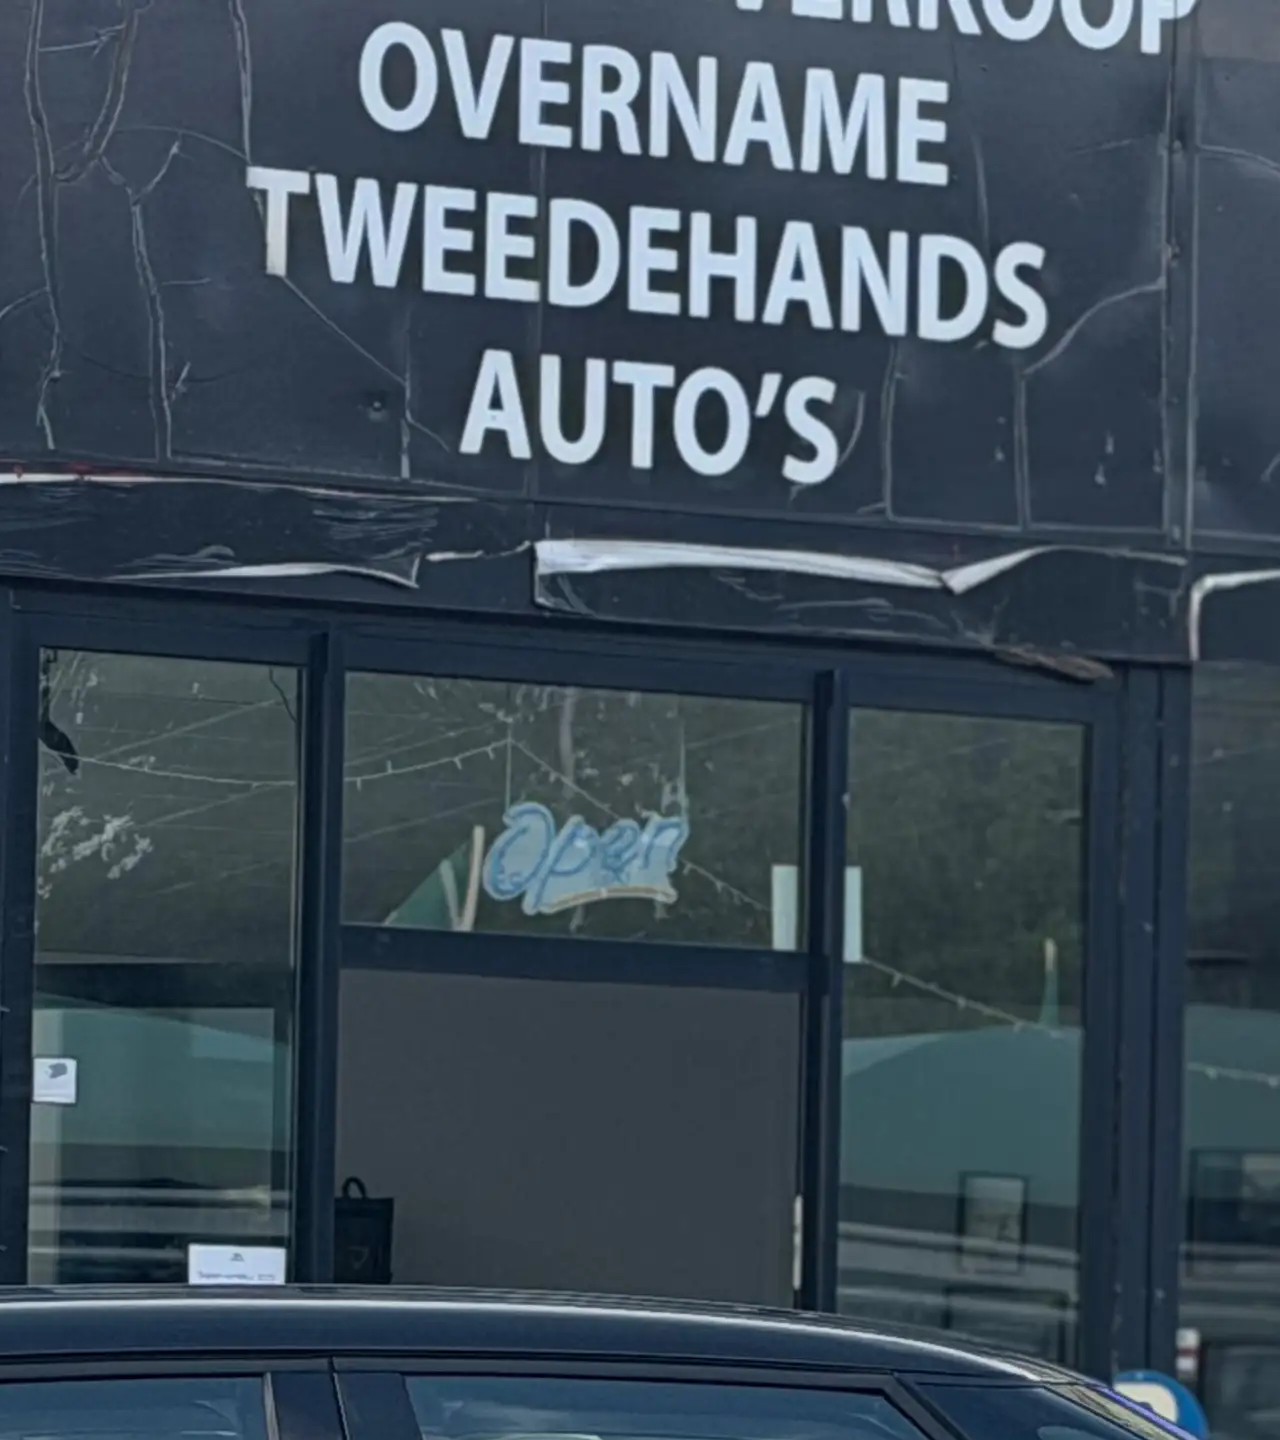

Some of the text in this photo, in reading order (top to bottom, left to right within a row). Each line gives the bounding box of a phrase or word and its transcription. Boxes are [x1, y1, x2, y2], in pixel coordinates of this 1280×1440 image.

[359, 22, 950, 185] OVERNAME
[246, 166, 1048, 349] TWEEDEHANDS
[458, 348, 839, 485] AUTO'S
[484, 801, 689, 914] Open
